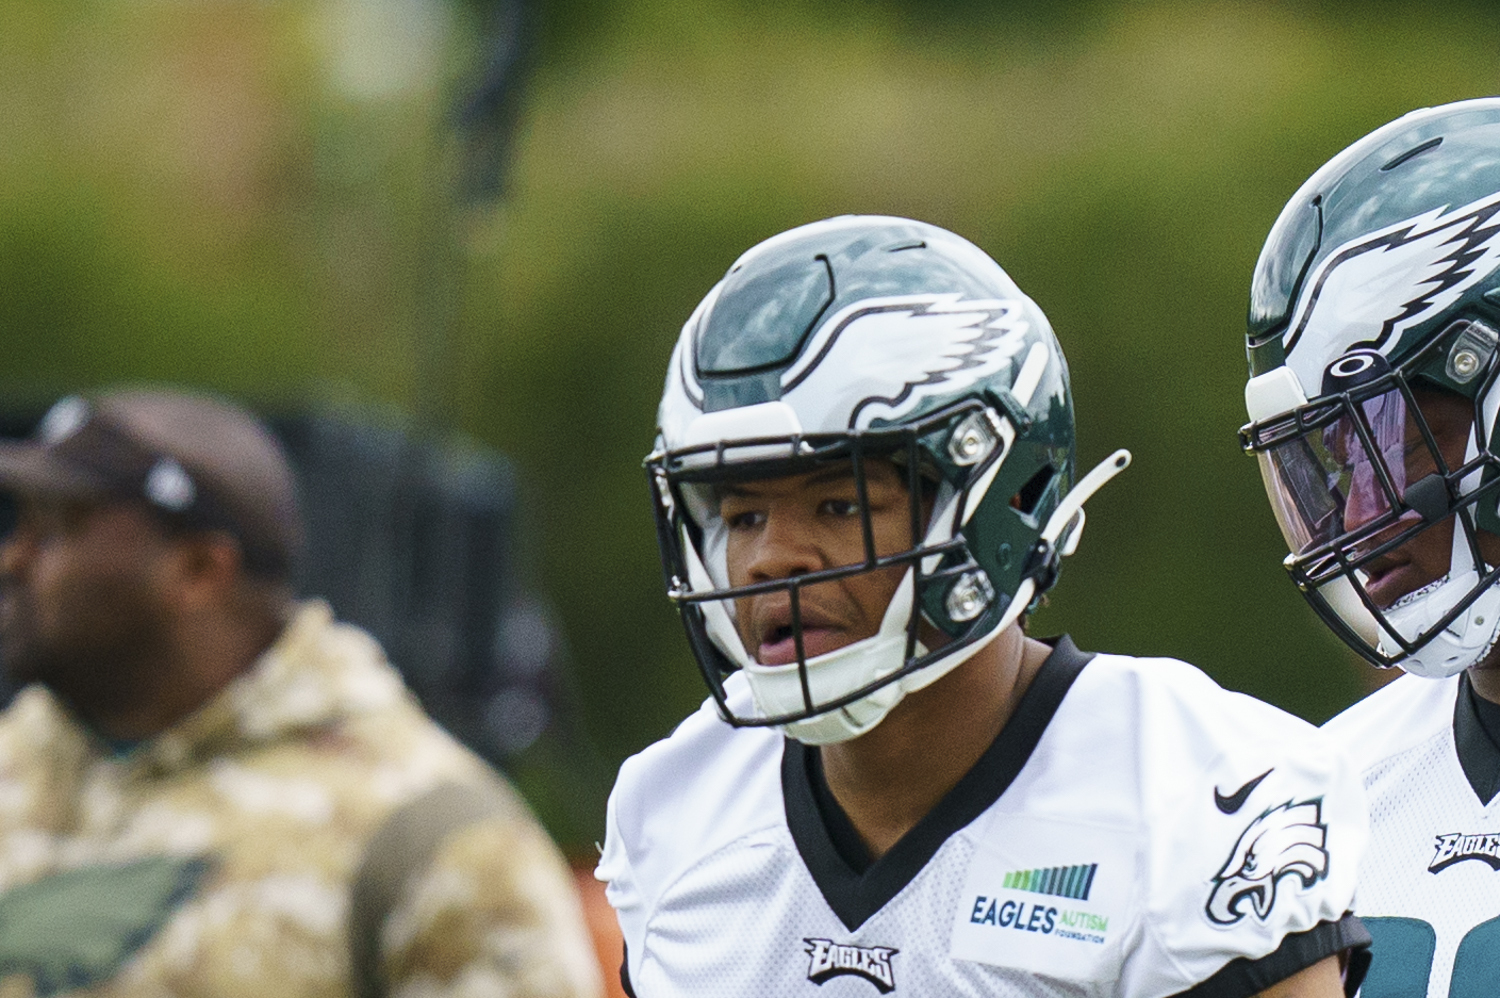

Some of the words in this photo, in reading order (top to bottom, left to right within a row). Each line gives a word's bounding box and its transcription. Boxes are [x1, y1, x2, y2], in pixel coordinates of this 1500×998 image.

[970, 896, 1058, 934] EAGLES
[1059, 909, 1109, 931] AUTISM
[803, 938, 899, 994] EAGLES
